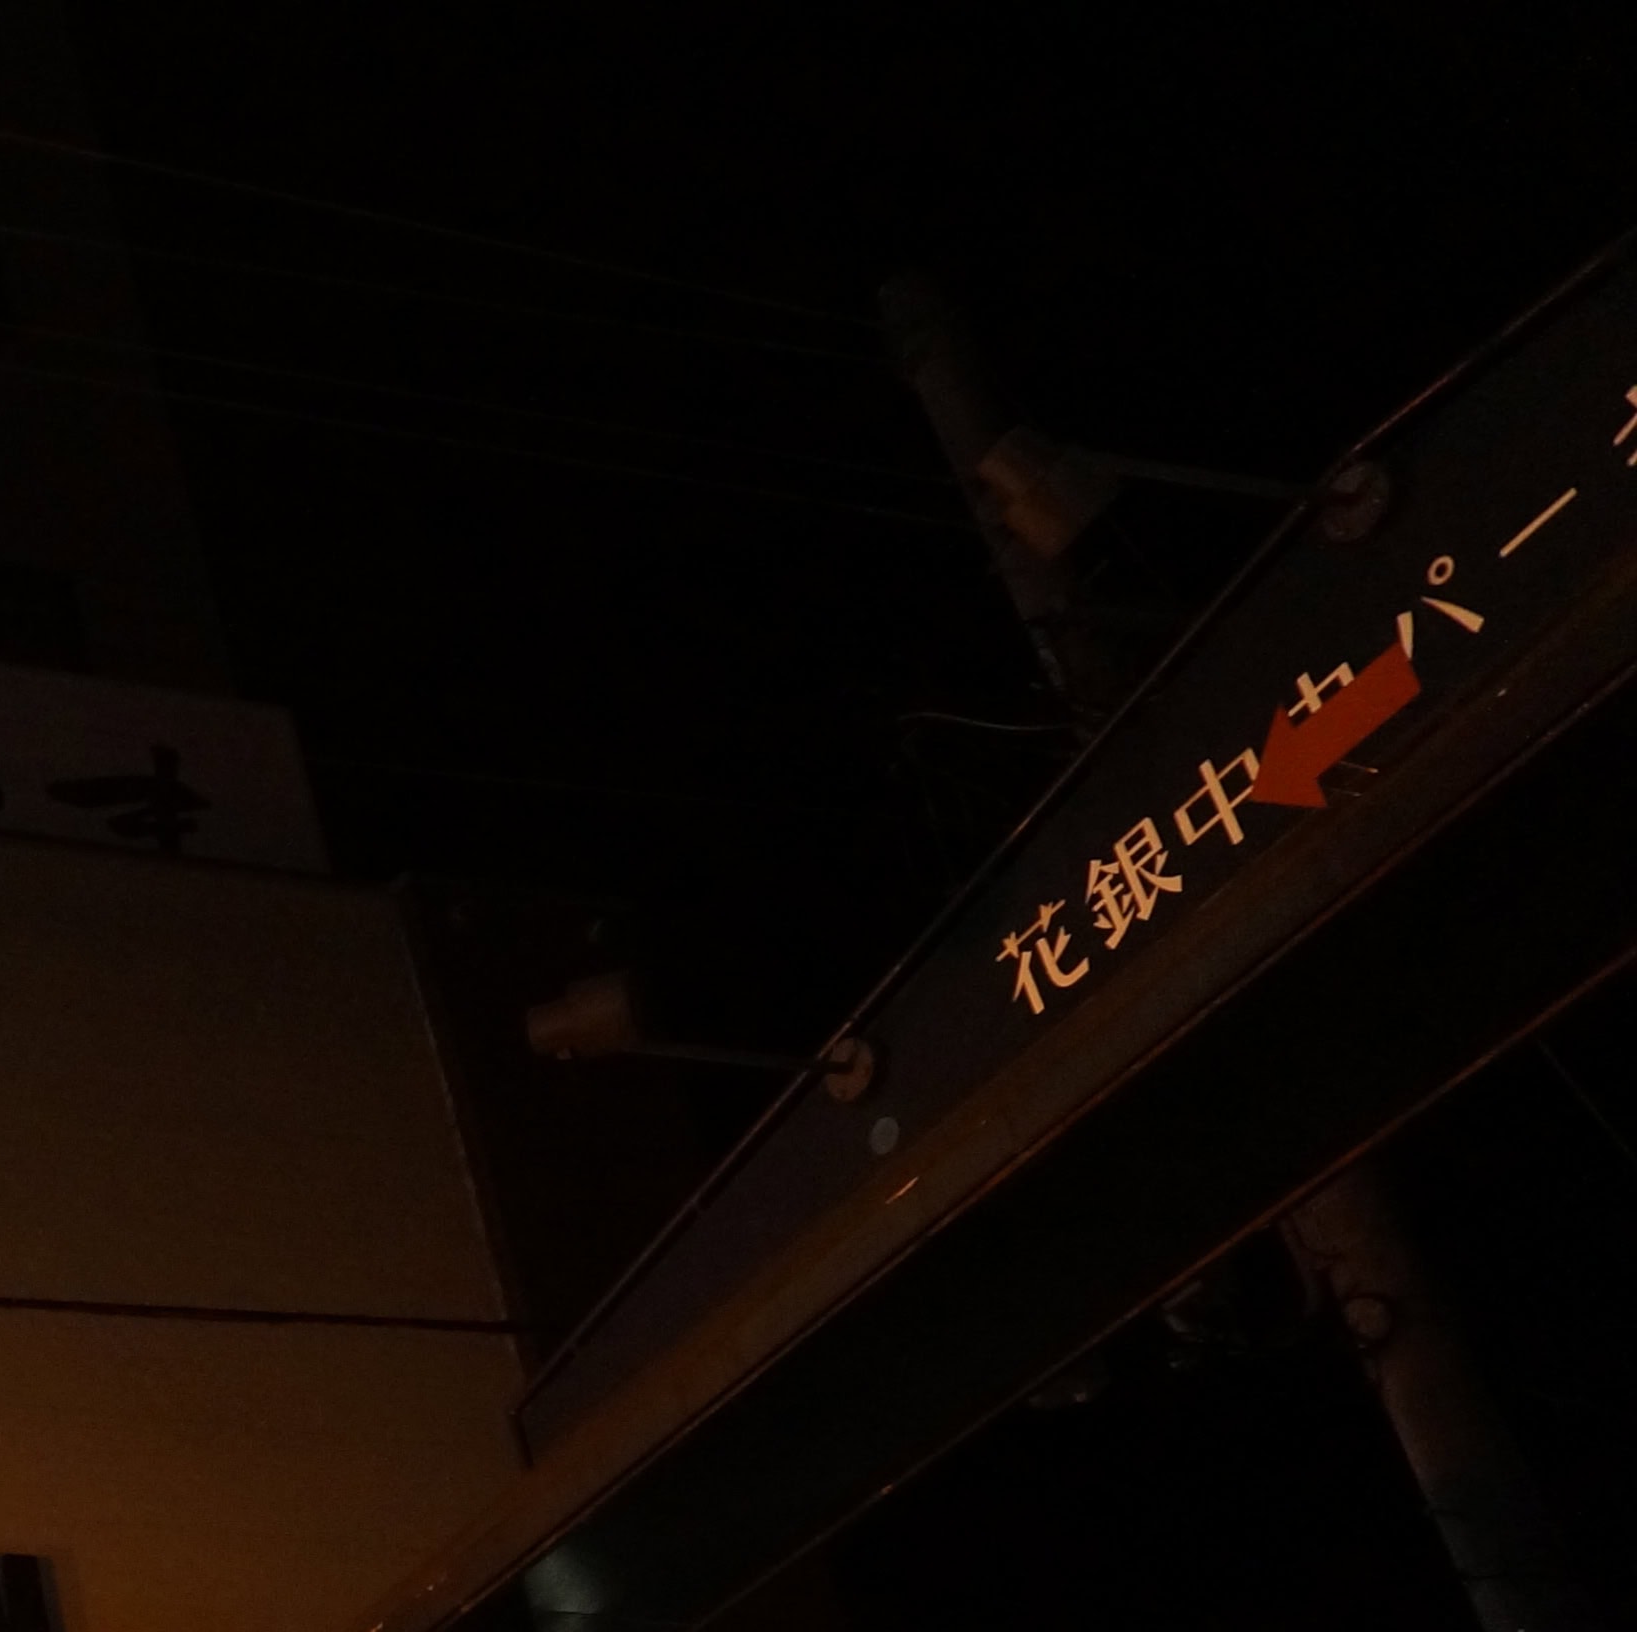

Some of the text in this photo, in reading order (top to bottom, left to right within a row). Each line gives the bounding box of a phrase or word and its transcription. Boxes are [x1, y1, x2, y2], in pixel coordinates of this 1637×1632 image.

[996, 382, 1637, 1016] 花銀中パー
